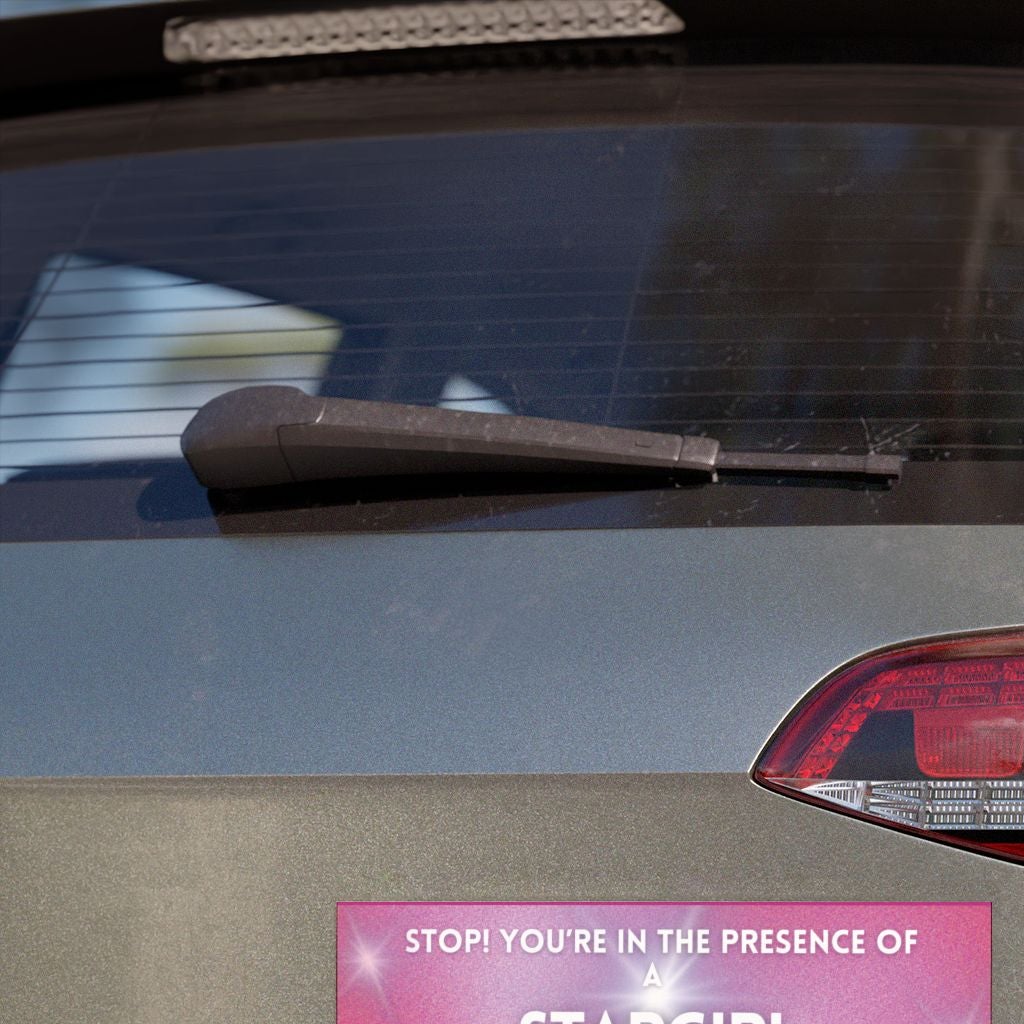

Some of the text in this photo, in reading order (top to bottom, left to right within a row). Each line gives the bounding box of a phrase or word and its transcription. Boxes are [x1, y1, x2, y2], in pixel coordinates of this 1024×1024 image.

[405, 928, 919, 955] STOP! YOU'RE IN THE PRESENCE OF
[642, 961, 663, 987] A
